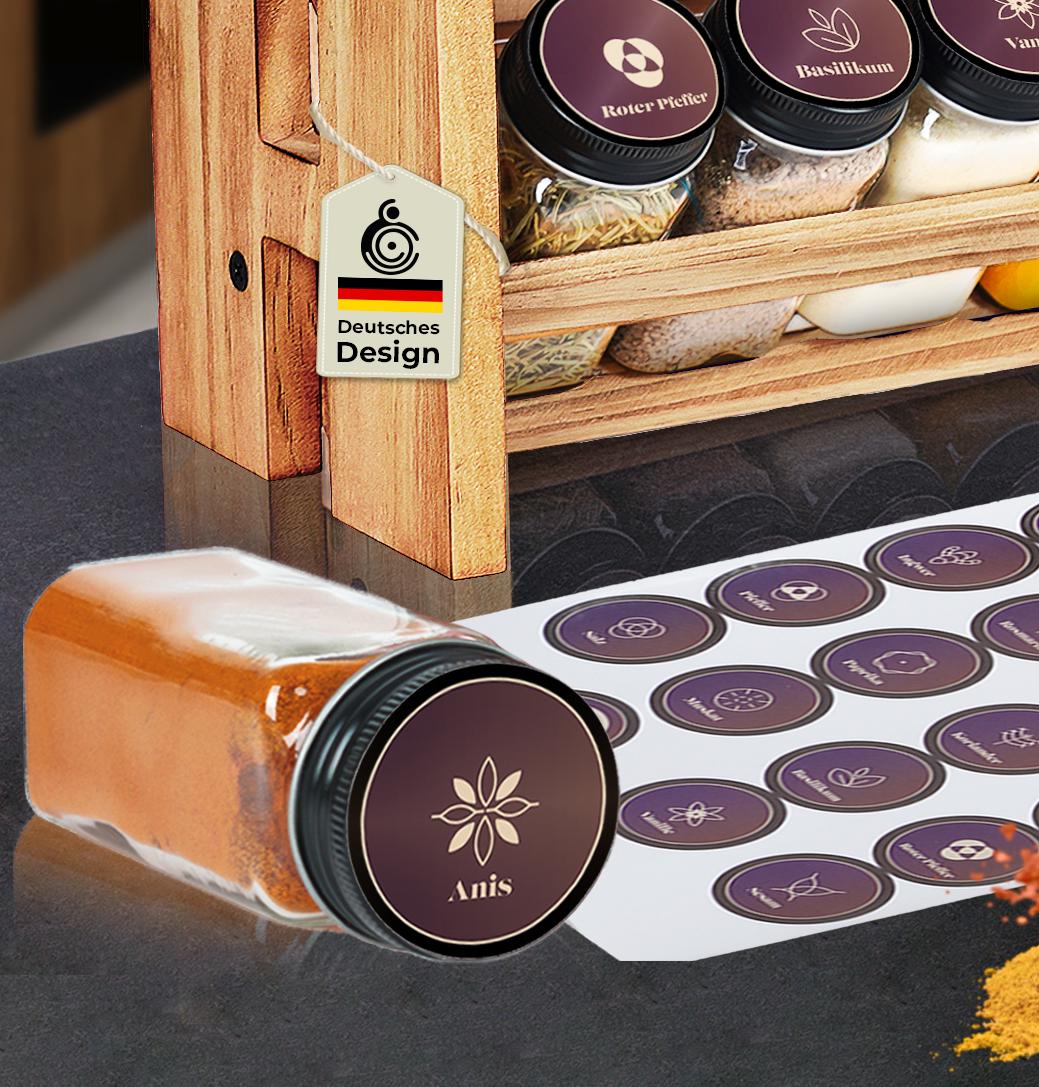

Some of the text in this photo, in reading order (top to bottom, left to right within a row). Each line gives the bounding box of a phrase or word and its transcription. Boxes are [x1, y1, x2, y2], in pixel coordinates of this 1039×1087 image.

[795, 61, 896, 80] Basilikum
[601, 91, 710, 119] Roter Pfeffer
[338, 319, 440, 335] Deutsches
[337, 339, 440, 370] Design
[896, 553, 937, 577] Ingwer
[447, 872, 515, 902] Anis
